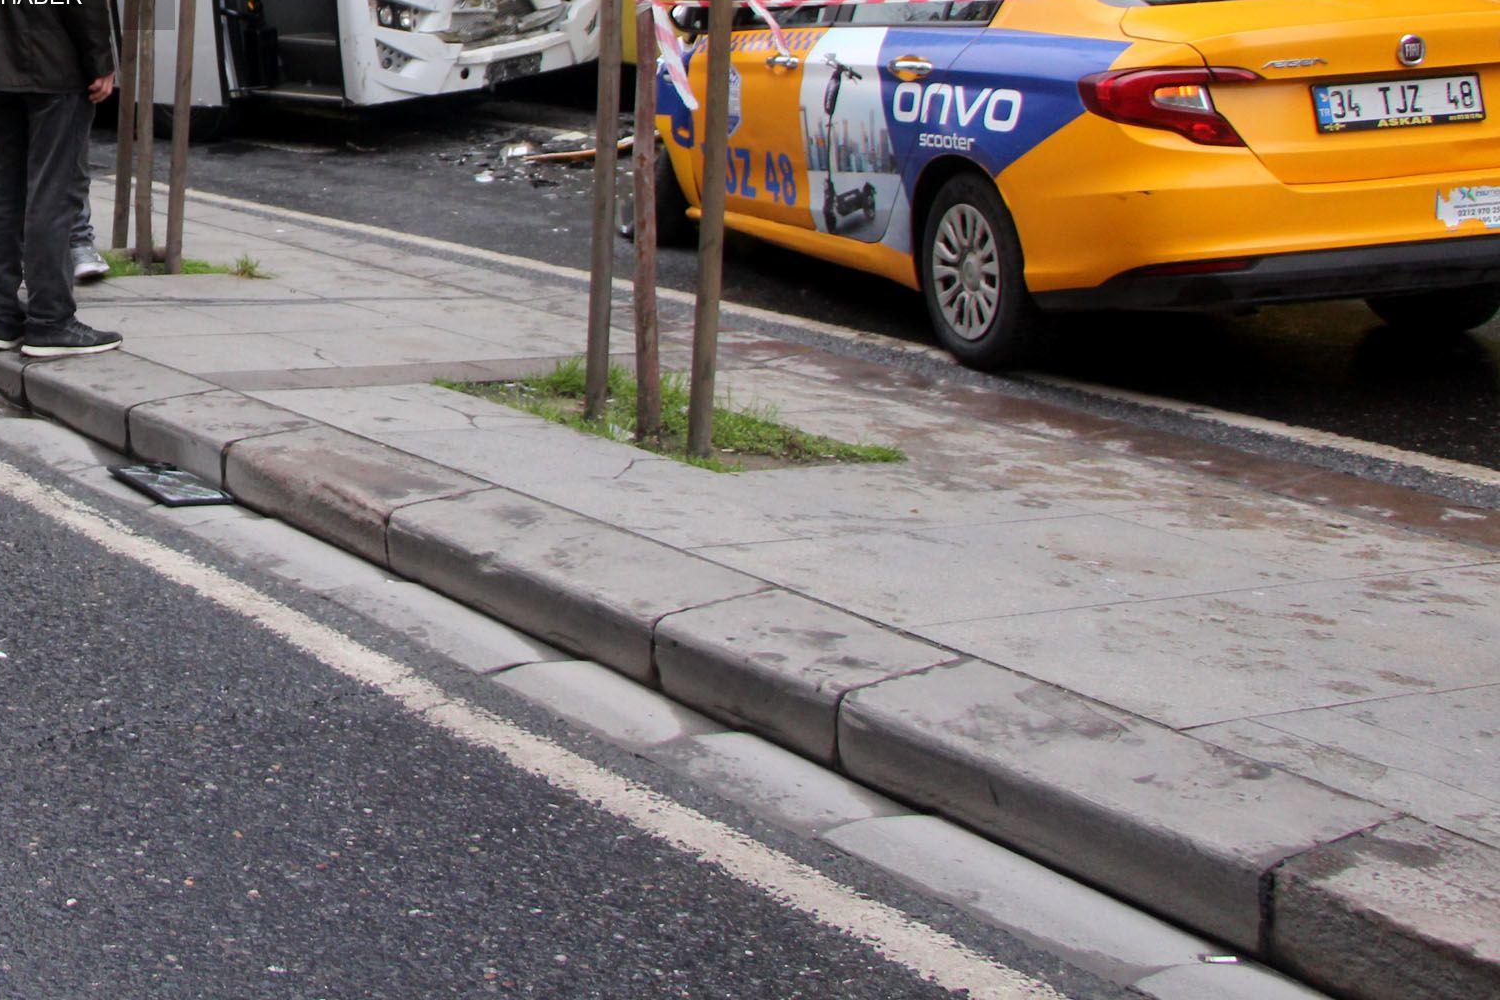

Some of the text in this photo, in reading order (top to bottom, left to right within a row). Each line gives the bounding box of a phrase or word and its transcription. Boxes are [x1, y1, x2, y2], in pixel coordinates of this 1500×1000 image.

[1330, 80, 1475, 119] 34 TJZ 48
[1318, 107, 1332, 118] TR
[1377, 113, 1434, 129] ASKAR
[918, 131, 976, 152] scooter
[764, 150, 798, 207] 48
